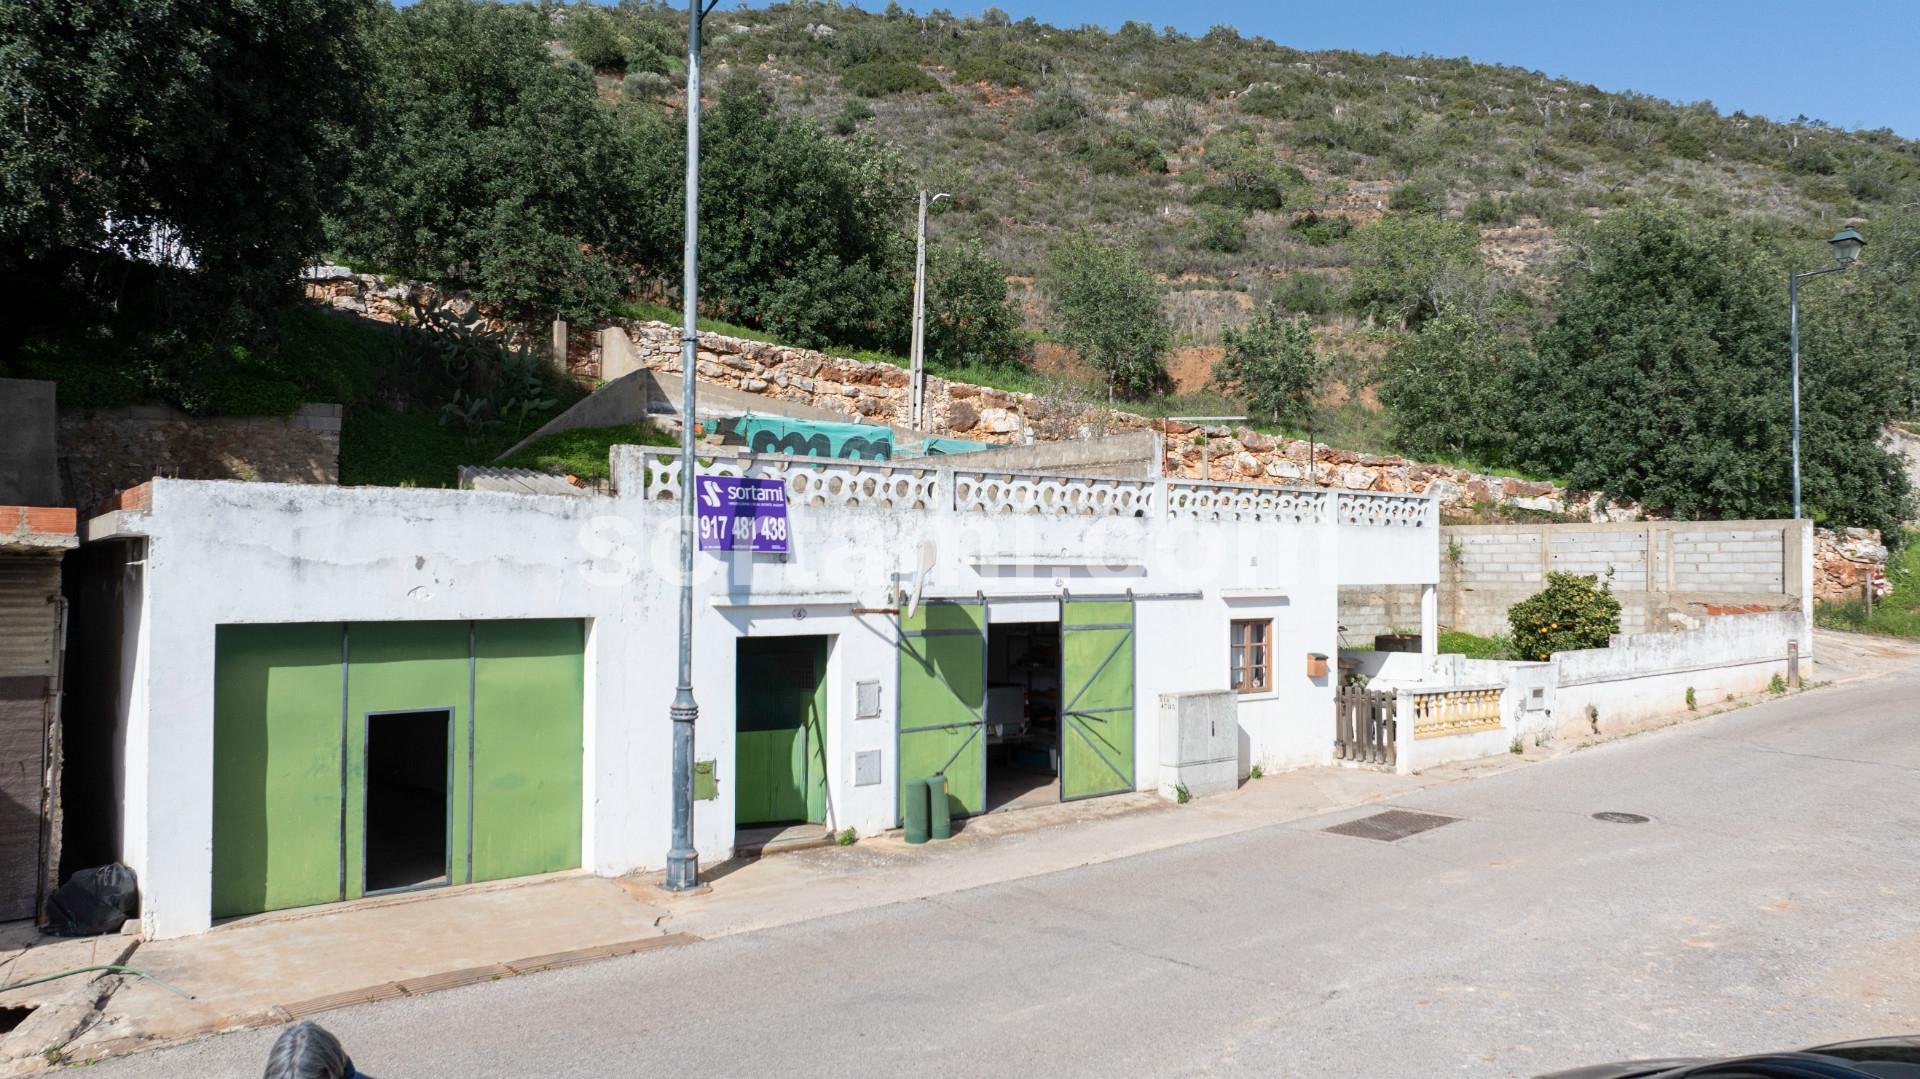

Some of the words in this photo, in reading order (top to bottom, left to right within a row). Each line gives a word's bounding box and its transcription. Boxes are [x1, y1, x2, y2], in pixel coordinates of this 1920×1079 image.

[727, 485, 784, 502] sortami
[701, 515, 728, 540] 917
[732, 516, 757, 540] 481
[761, 516, 786, 541] 438
